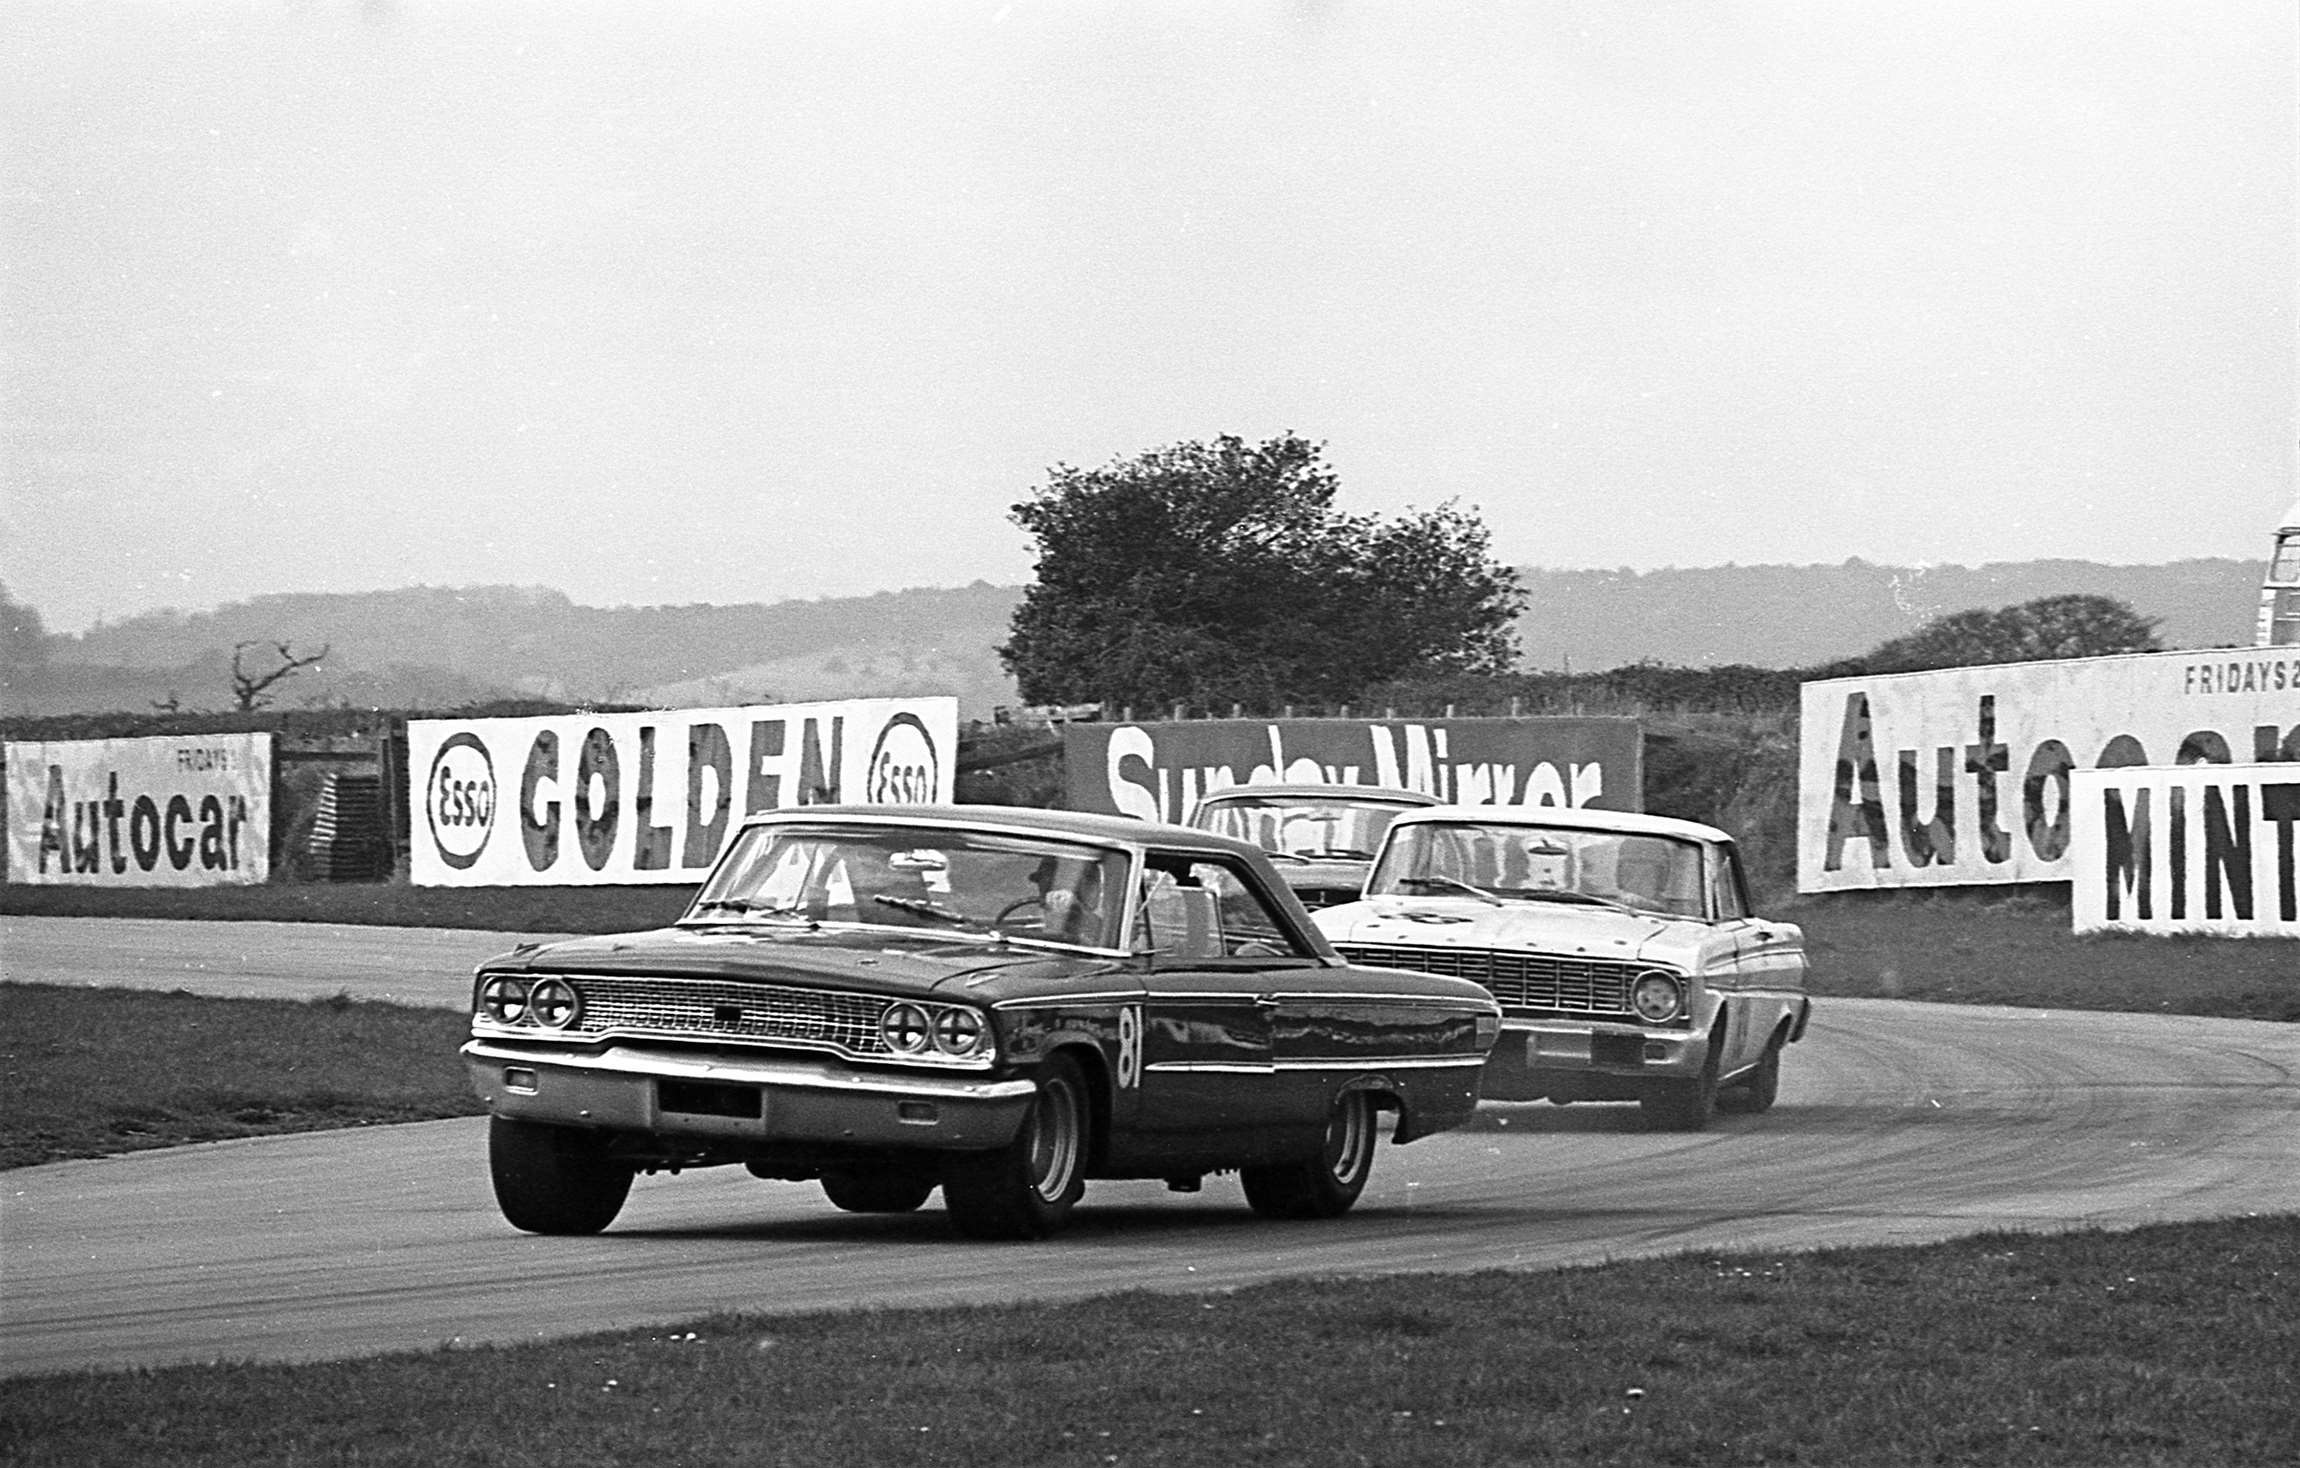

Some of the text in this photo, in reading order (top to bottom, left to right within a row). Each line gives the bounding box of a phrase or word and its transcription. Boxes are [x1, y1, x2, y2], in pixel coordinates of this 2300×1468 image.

[39, 764, 247, 874] Autocar
[440, 765, 490, 828] Esso
[519, 716, 844, 872] GOLDEN
[1108, 725, 1359, 827] Sud
[1823, 690, 2300, 868] Auto
